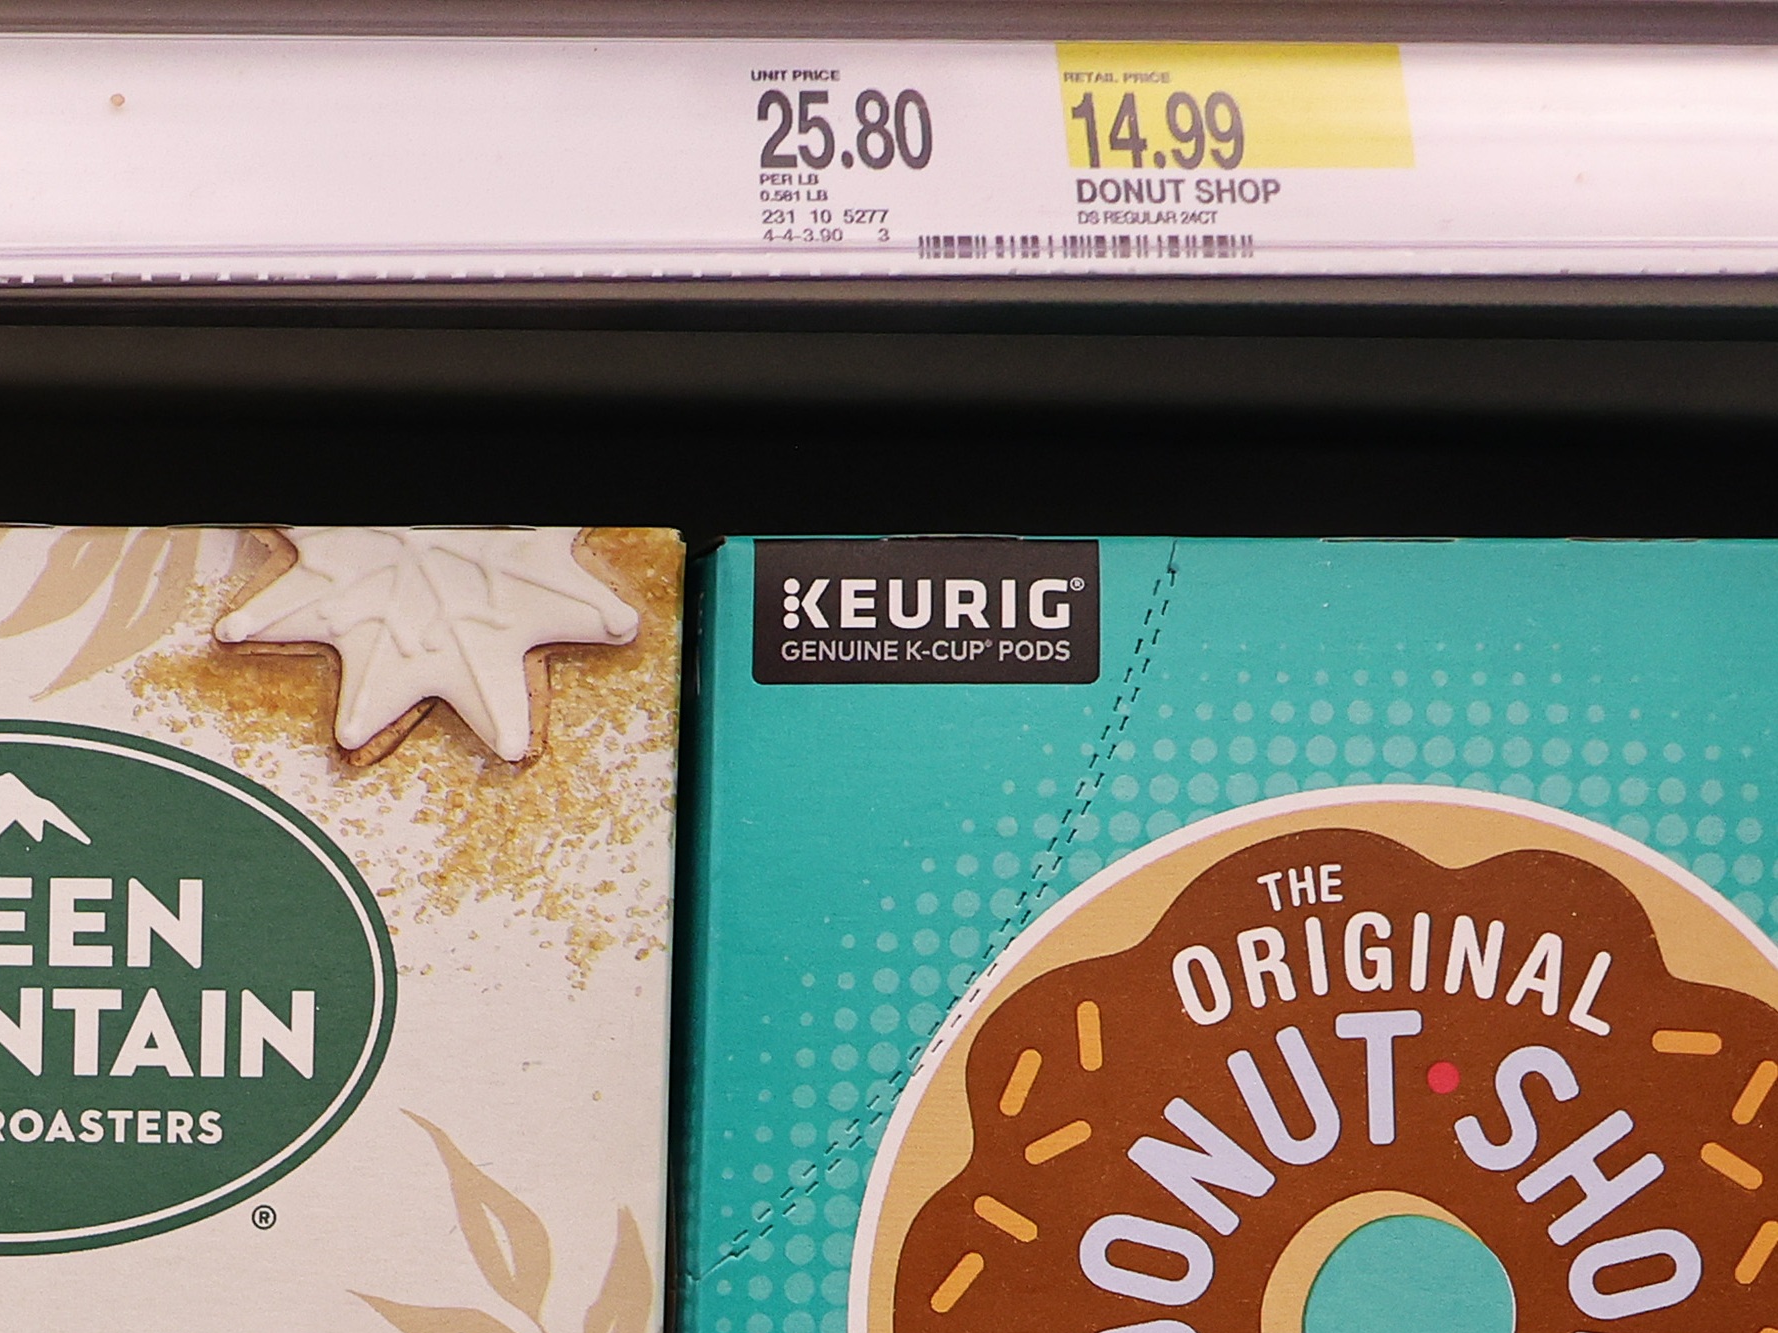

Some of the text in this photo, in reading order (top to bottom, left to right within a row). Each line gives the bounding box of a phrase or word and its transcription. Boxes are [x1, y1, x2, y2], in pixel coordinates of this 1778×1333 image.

[757, 89, 934, 170] 25.80
[1072, 91, 1244, 170] 14.99
[1076, 179, 1281, 204] DONUT SHOP
[1257, 864, 1344, 912] THE
[1171, 911, 1612, 1037] ORIGINAL
